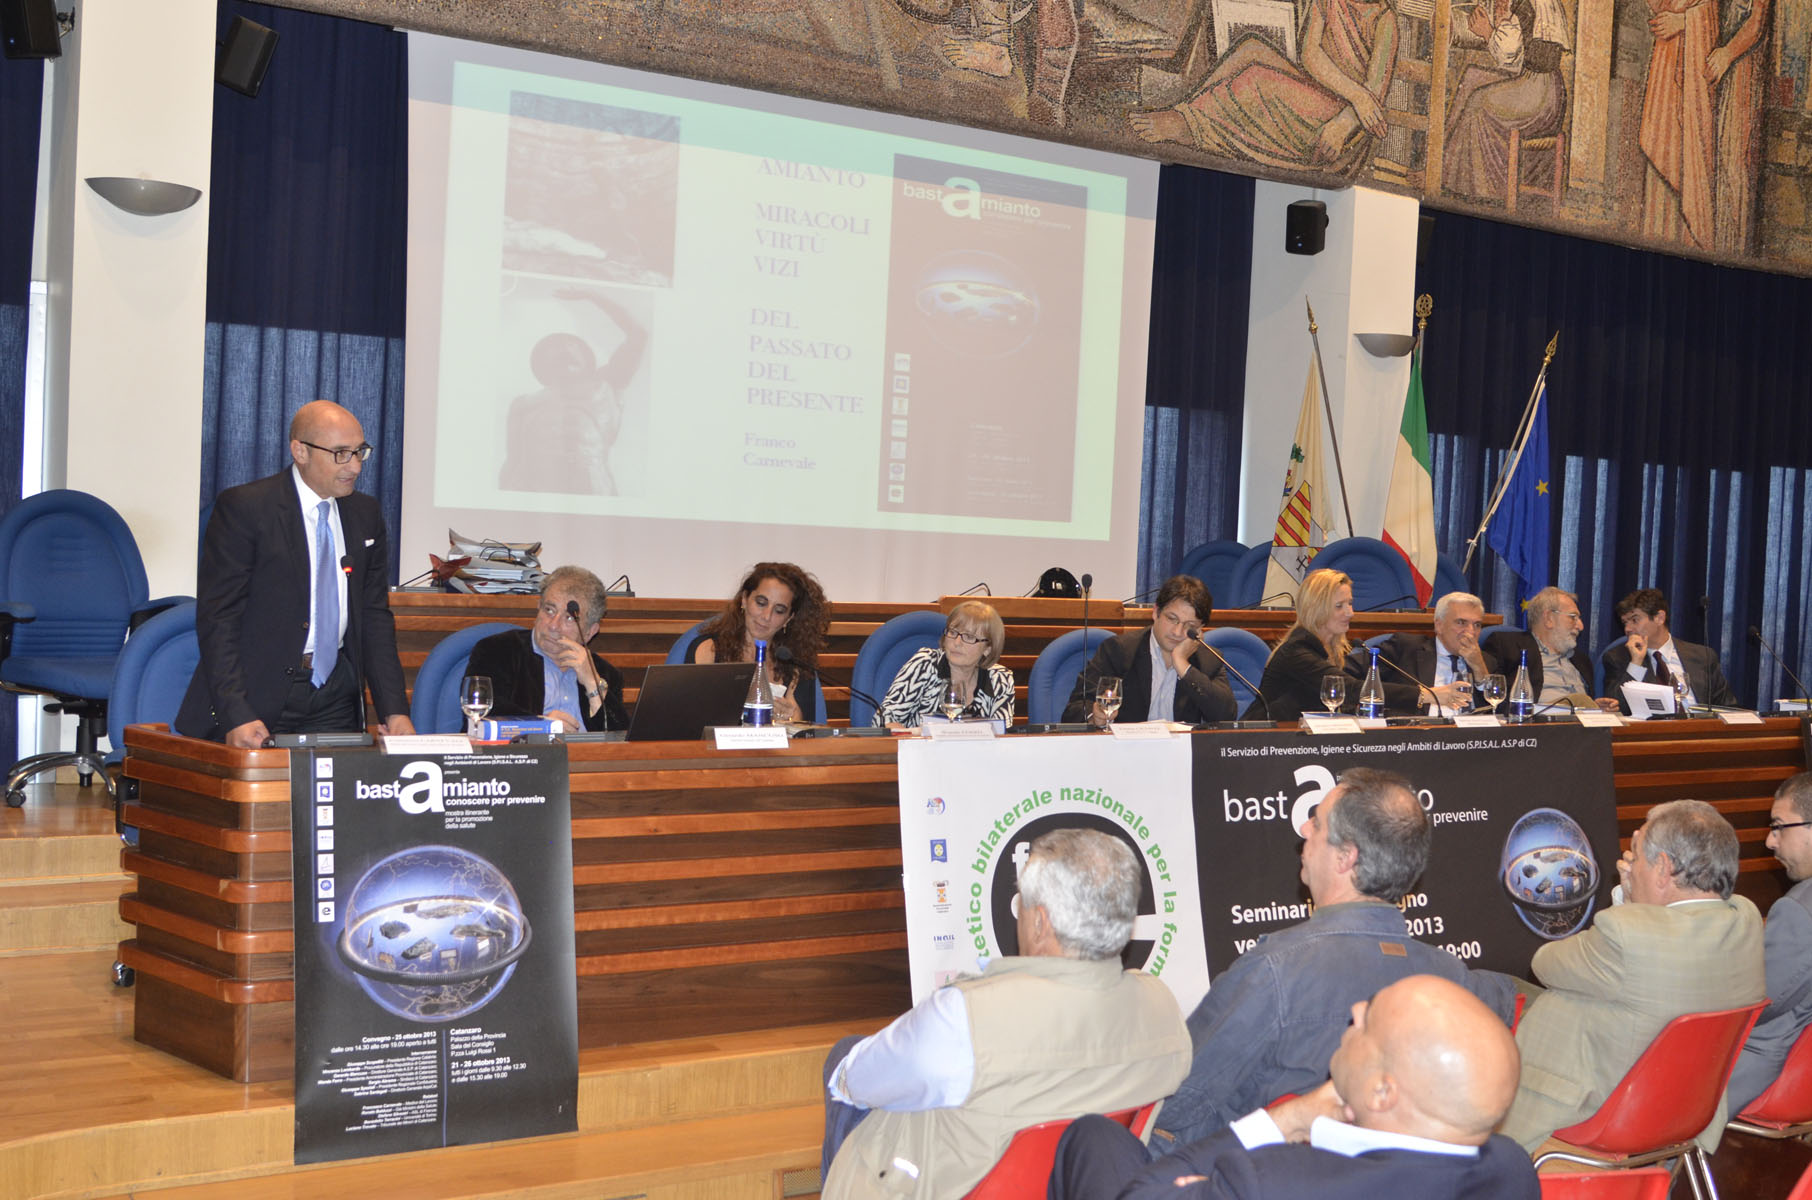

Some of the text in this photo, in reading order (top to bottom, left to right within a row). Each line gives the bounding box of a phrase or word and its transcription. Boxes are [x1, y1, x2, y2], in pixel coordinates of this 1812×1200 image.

[758, 157, 866, 189] AMIANTO
[755, 201, 871, 236] MIRACOLI
[752, 255, 801, 278] VIZI
[750, 307, 799, 329] DEL
[750, 334, 853, 362] PASSATO
[747, 360, 798, 382] DEL
[746, 386, 865, 415] PRESENTE
[743, 431, 797, 449] Franco
[742, 451, 817, 470] Carnevale
[1227, 747, 1259, 757] Servizio
[1260, 746, 1269, 756] di
[1269, 745, 1320, 756] Prevenzione,
[1320, 745, 1345, 757] Igiene
[1352, 743, 1387, 753] Sicurezza
[1387, 743, 1406, 754] negli
[1406, 742, 1432, 752] Ambiti
[1433, 741, 1441, 751] di
[1441, 741, 1466, 750] Lavoro
[1517, 738, 1525, 748] di
[1525, 738, 1537, 748] CZ)
[445, 794, 546, 807] conoscere per prevenire
[1433, 808, 1489, 827] prevenire
[971, 790, 1053, 875] bilaterale
[1060, 787, 1150, 841] nazionale
[1146, 843, 1172, 883] per
[1163, 890, 1177, 913] la
[1231, 898, 1316, 924] Seminari
[1405, 915, 1445, 936] 2013
[362, 1035, 391, 1043] Convegno
[449, 1027, 482, 1035] Catanzaro
[472, 1059, 495, 1067] ottobre
